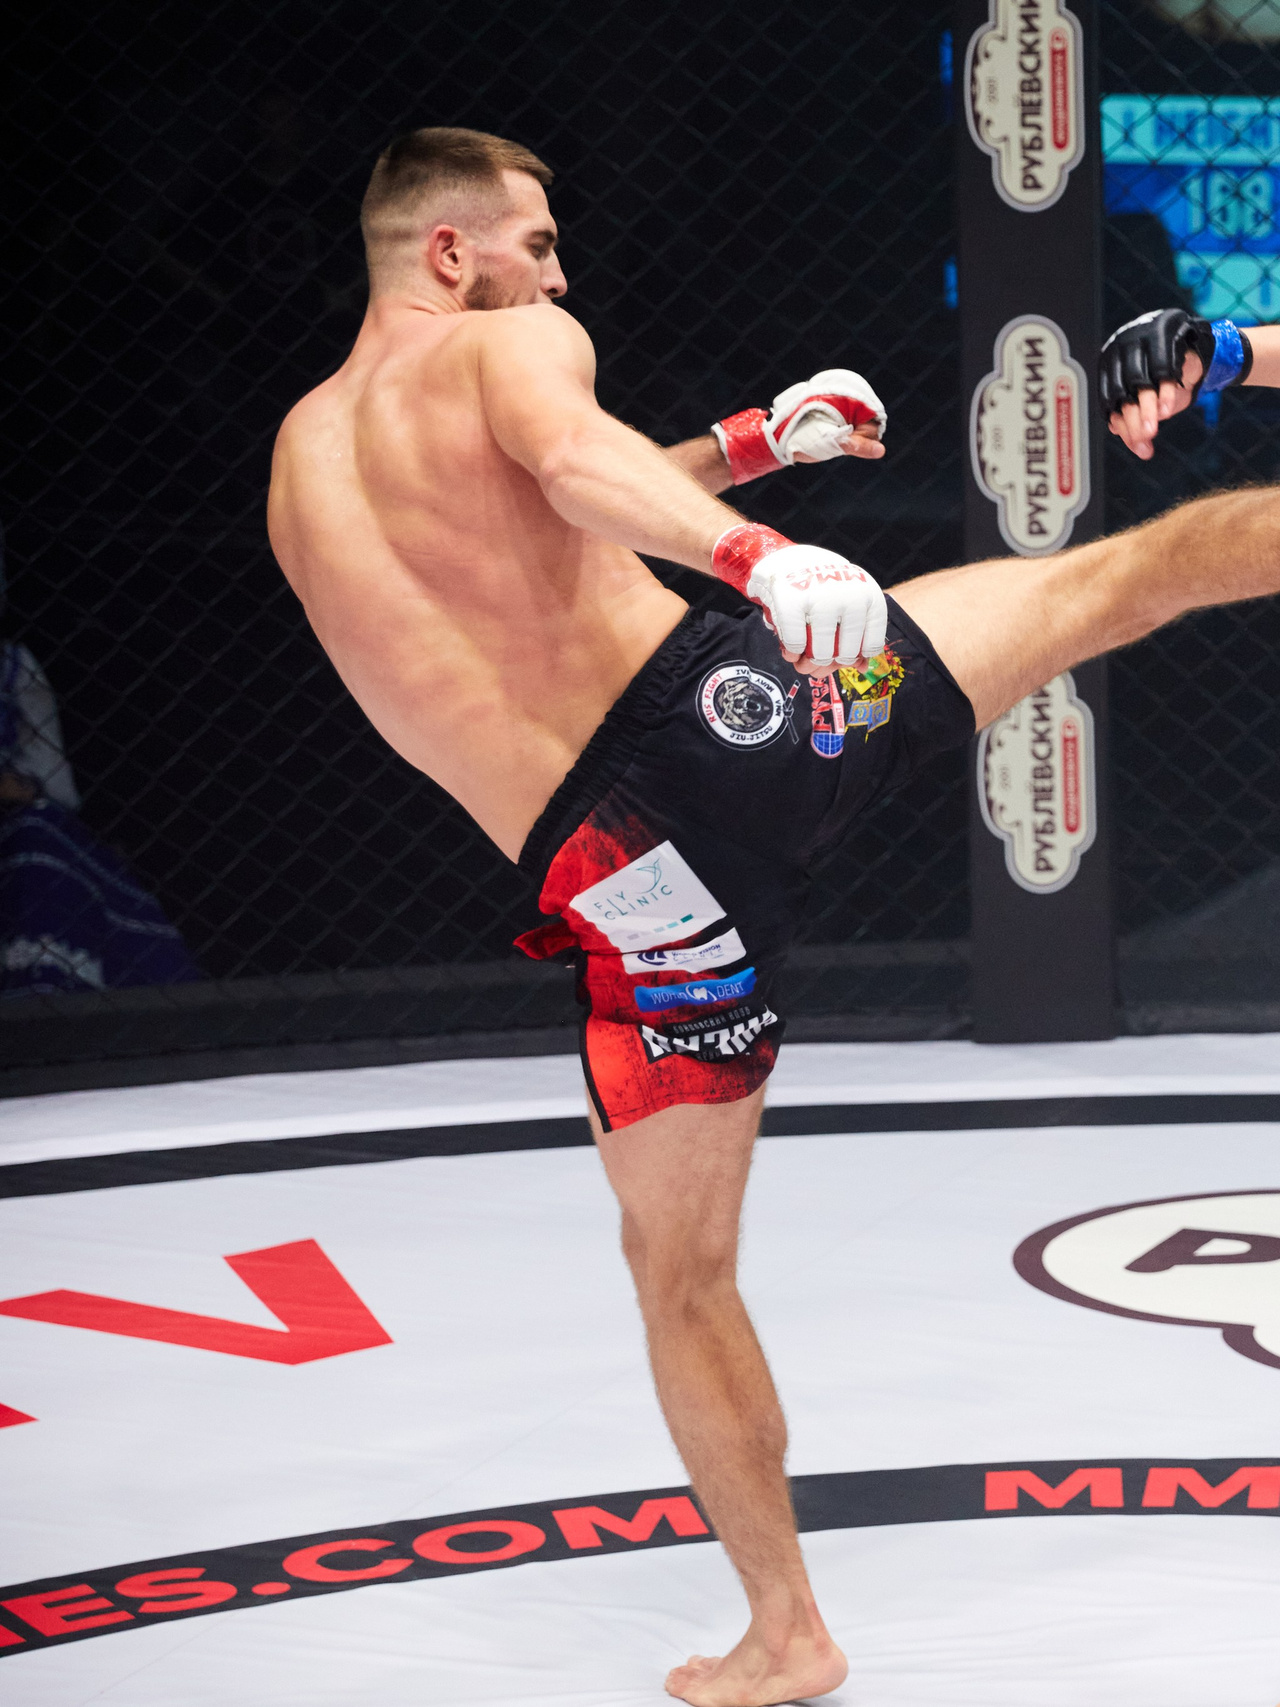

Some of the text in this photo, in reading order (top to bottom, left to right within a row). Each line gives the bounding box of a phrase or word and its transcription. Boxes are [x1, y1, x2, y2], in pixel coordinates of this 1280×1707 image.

[790, 570, 868, 592] MMA
[703, 673, 723, 700] FIGHT
[729, 725, 773, 742] JIU-JITSU
[603, 884, 674, 921] CLINIC
[716, 981, 744, 998] DENT
